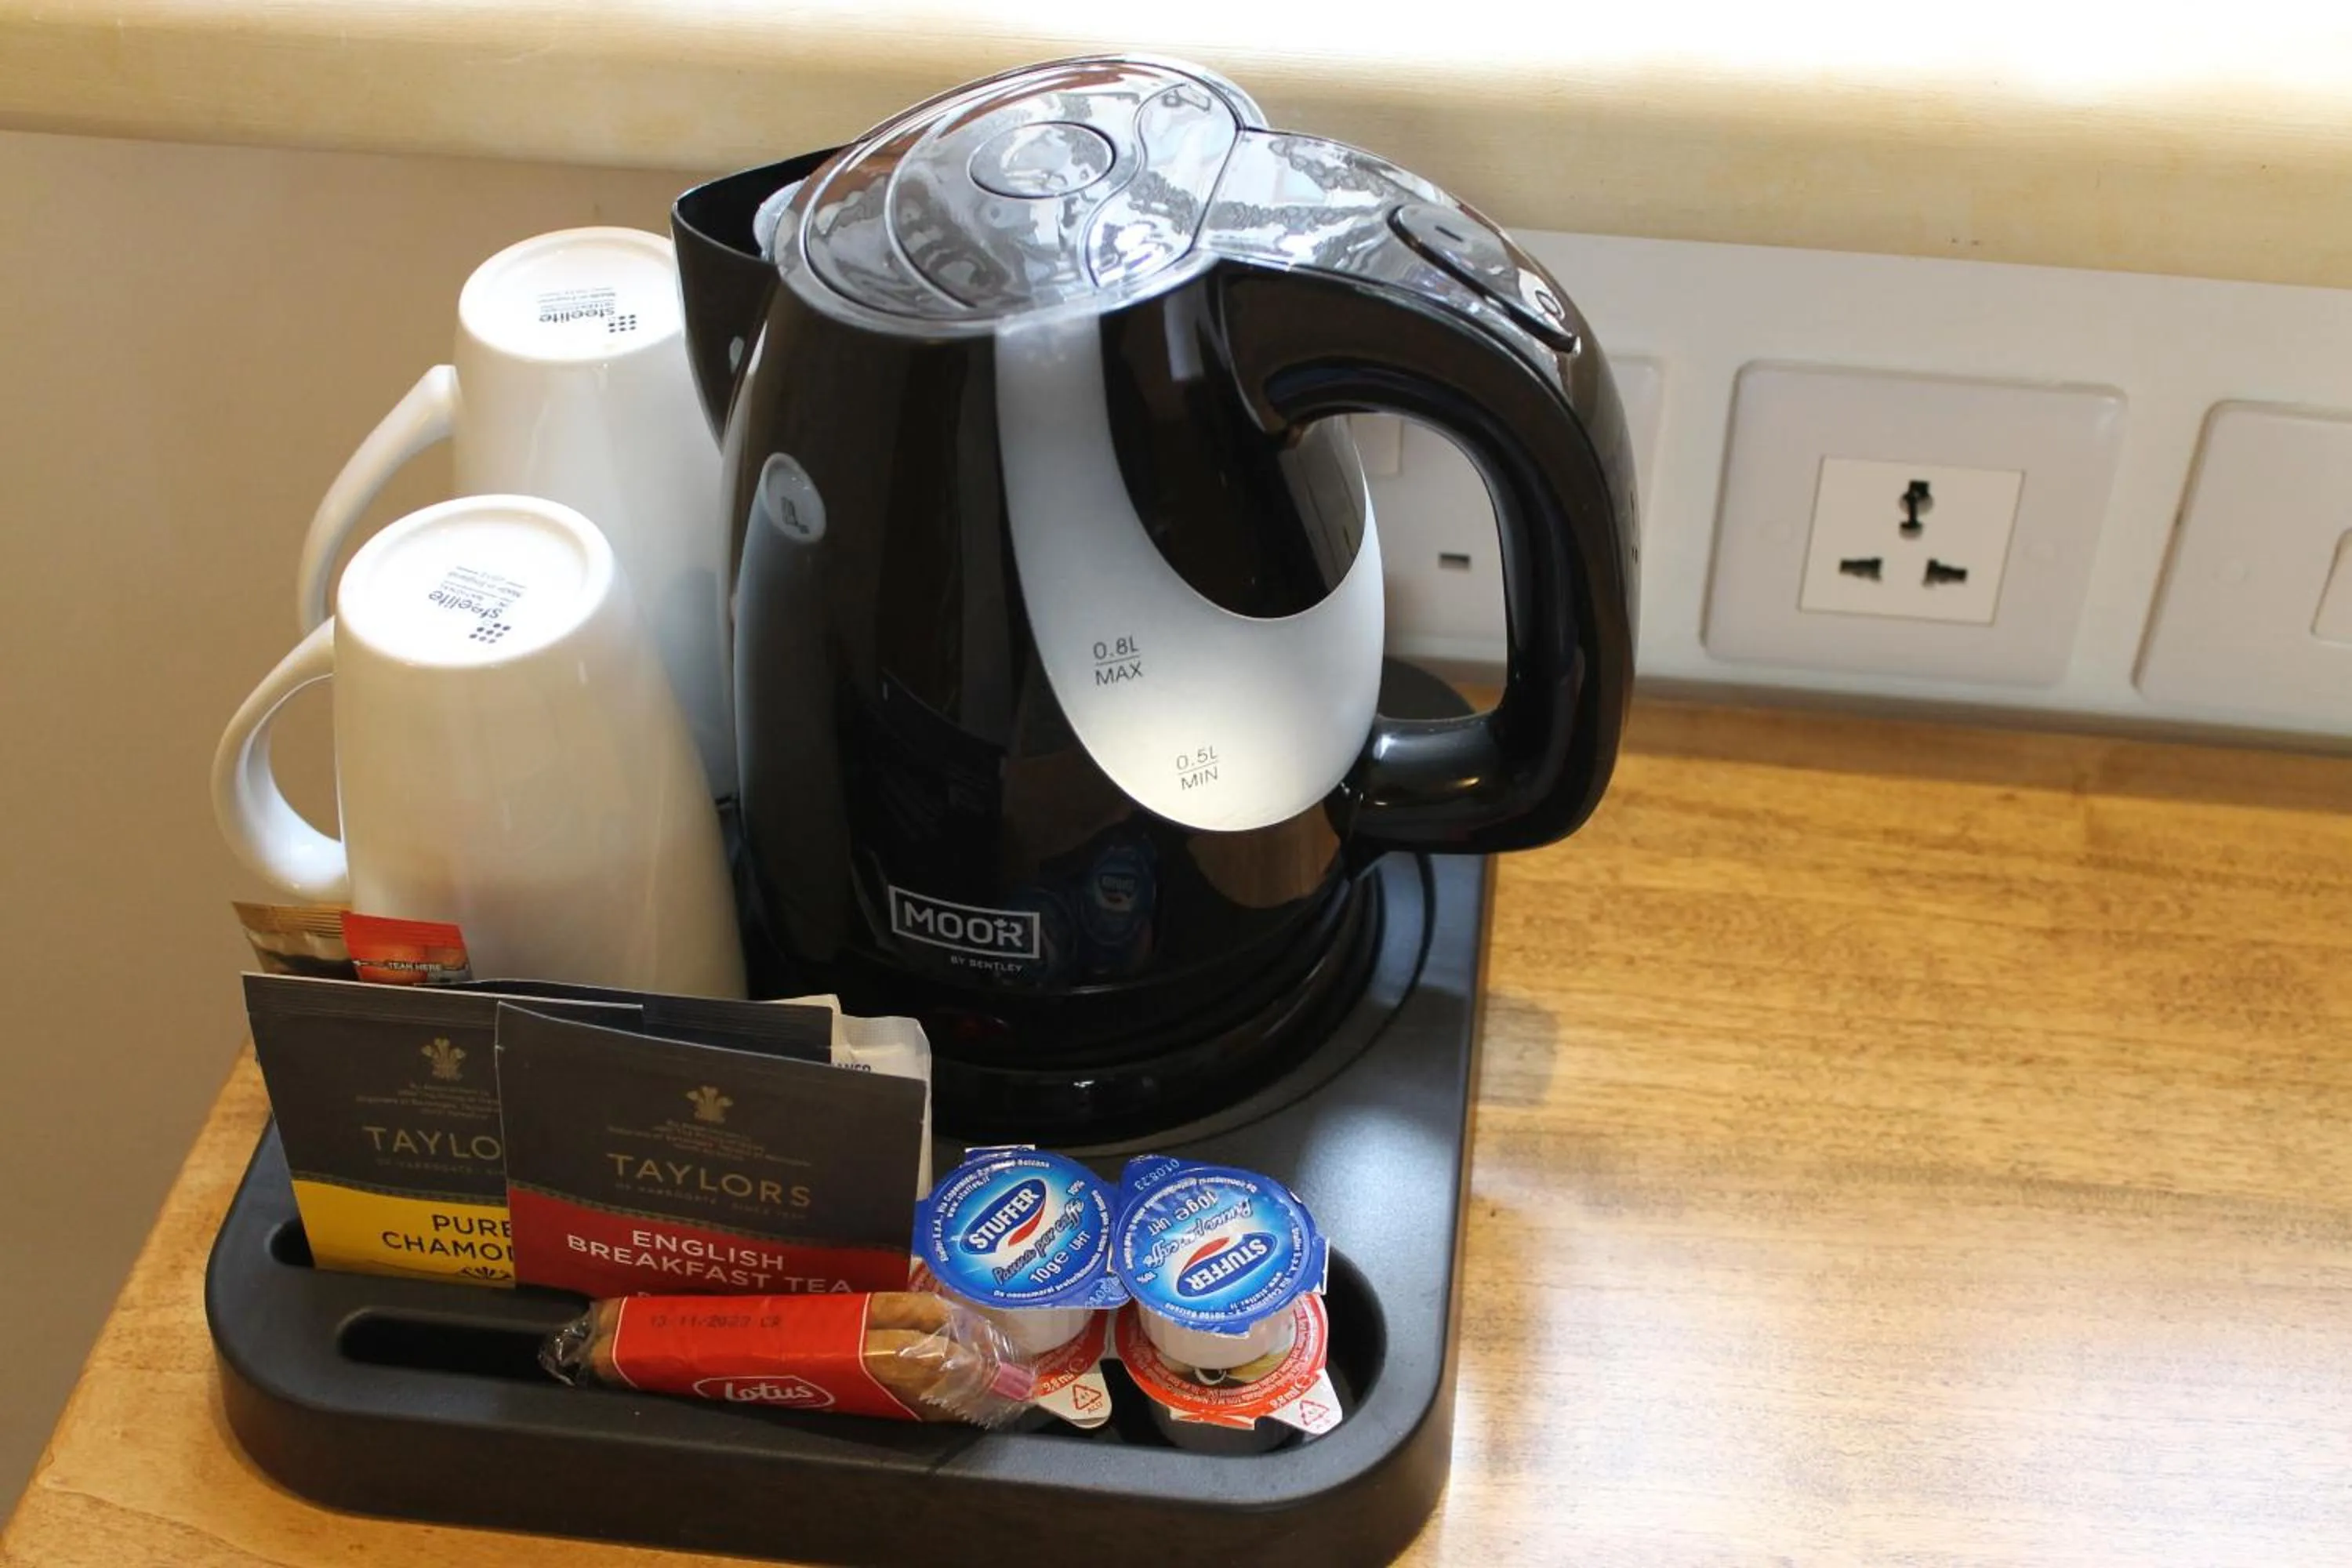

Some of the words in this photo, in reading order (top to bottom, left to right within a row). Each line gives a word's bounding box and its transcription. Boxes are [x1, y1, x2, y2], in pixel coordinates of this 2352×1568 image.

[539, 309, 615, 323] steelite
[429, 590, 503, 619] steelite
[1093, 634, 1140, 660] 0.8L
[1095, 662, 1143, 686] MAX
[1177, 746, 1218, 771] 0.5L
[1181, 767, 1218, 790] MIN
[904, 901, 1023, 947] MOOR
[969, 959, 1022, 972] BENTLEY
[362, 1126, 502, 1160] TAYLO
[607, 1152, 811, 1207] TAYLORS
[968, 1188, 1040, 1250] STUFFER
[1148, 1217, 1171, 1236] UHT
[382, 1231, 514, 1262] CHAMO
[633, 1229, 784, 1271] ENGLISH
[1069, 1231, 1091, 1250] UHT
[567, 1234, 772, 1289] BREAKFAST
[786, 1276, 853, 1294] TEA
[1185, 1238, 1268, 1291] STUFFER
[724, 1380, 815, 1403] Lotus
